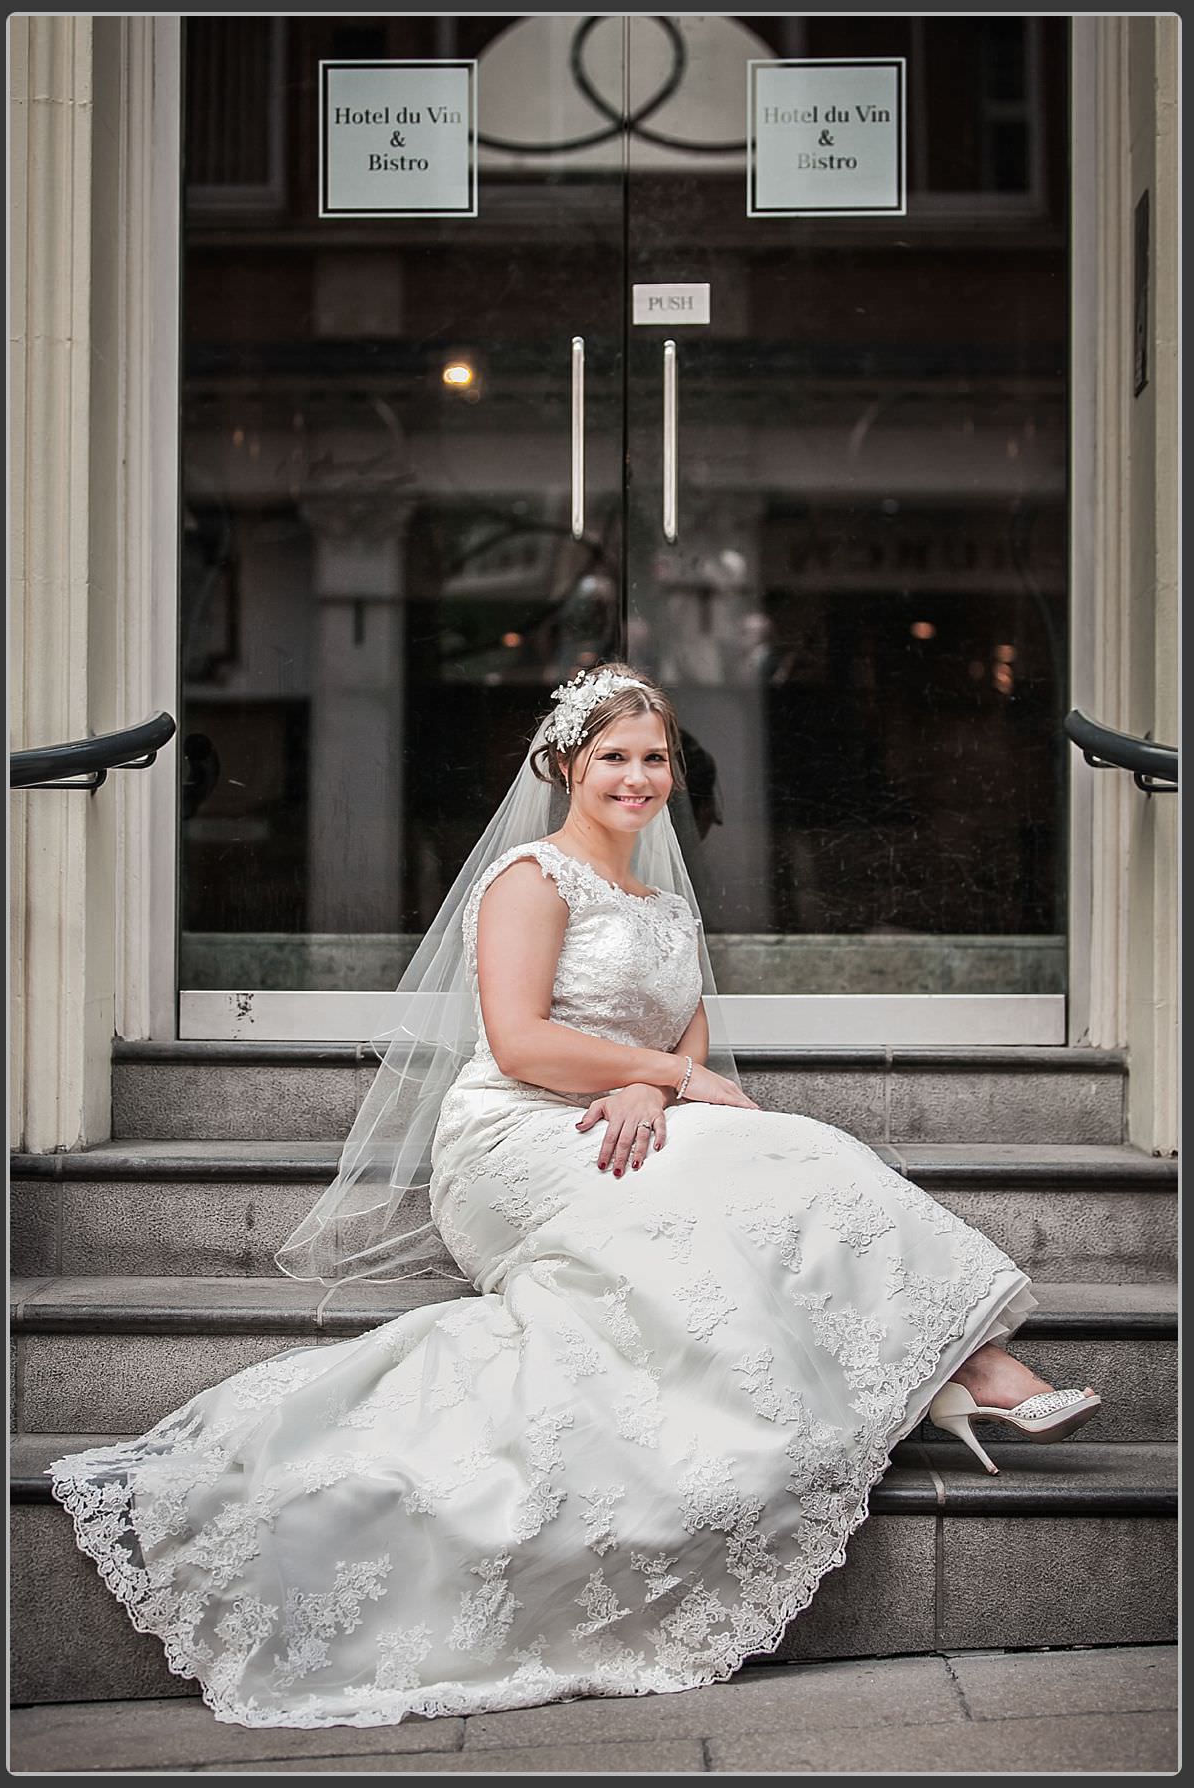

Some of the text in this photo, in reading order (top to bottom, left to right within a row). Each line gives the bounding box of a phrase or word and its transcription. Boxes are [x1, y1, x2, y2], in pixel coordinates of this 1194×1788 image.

[334, 106, 462, 125] Hotel du Vin
[764, 105, 891, 124] Hotel du Vin
[390, 130, 406, 148] &
[818, 129, 835, 147] &
[368, 154, 429, 171] Bistro
[797, 152, 858, 170] Bistro
[648, 296, 694, 311] PUSH
